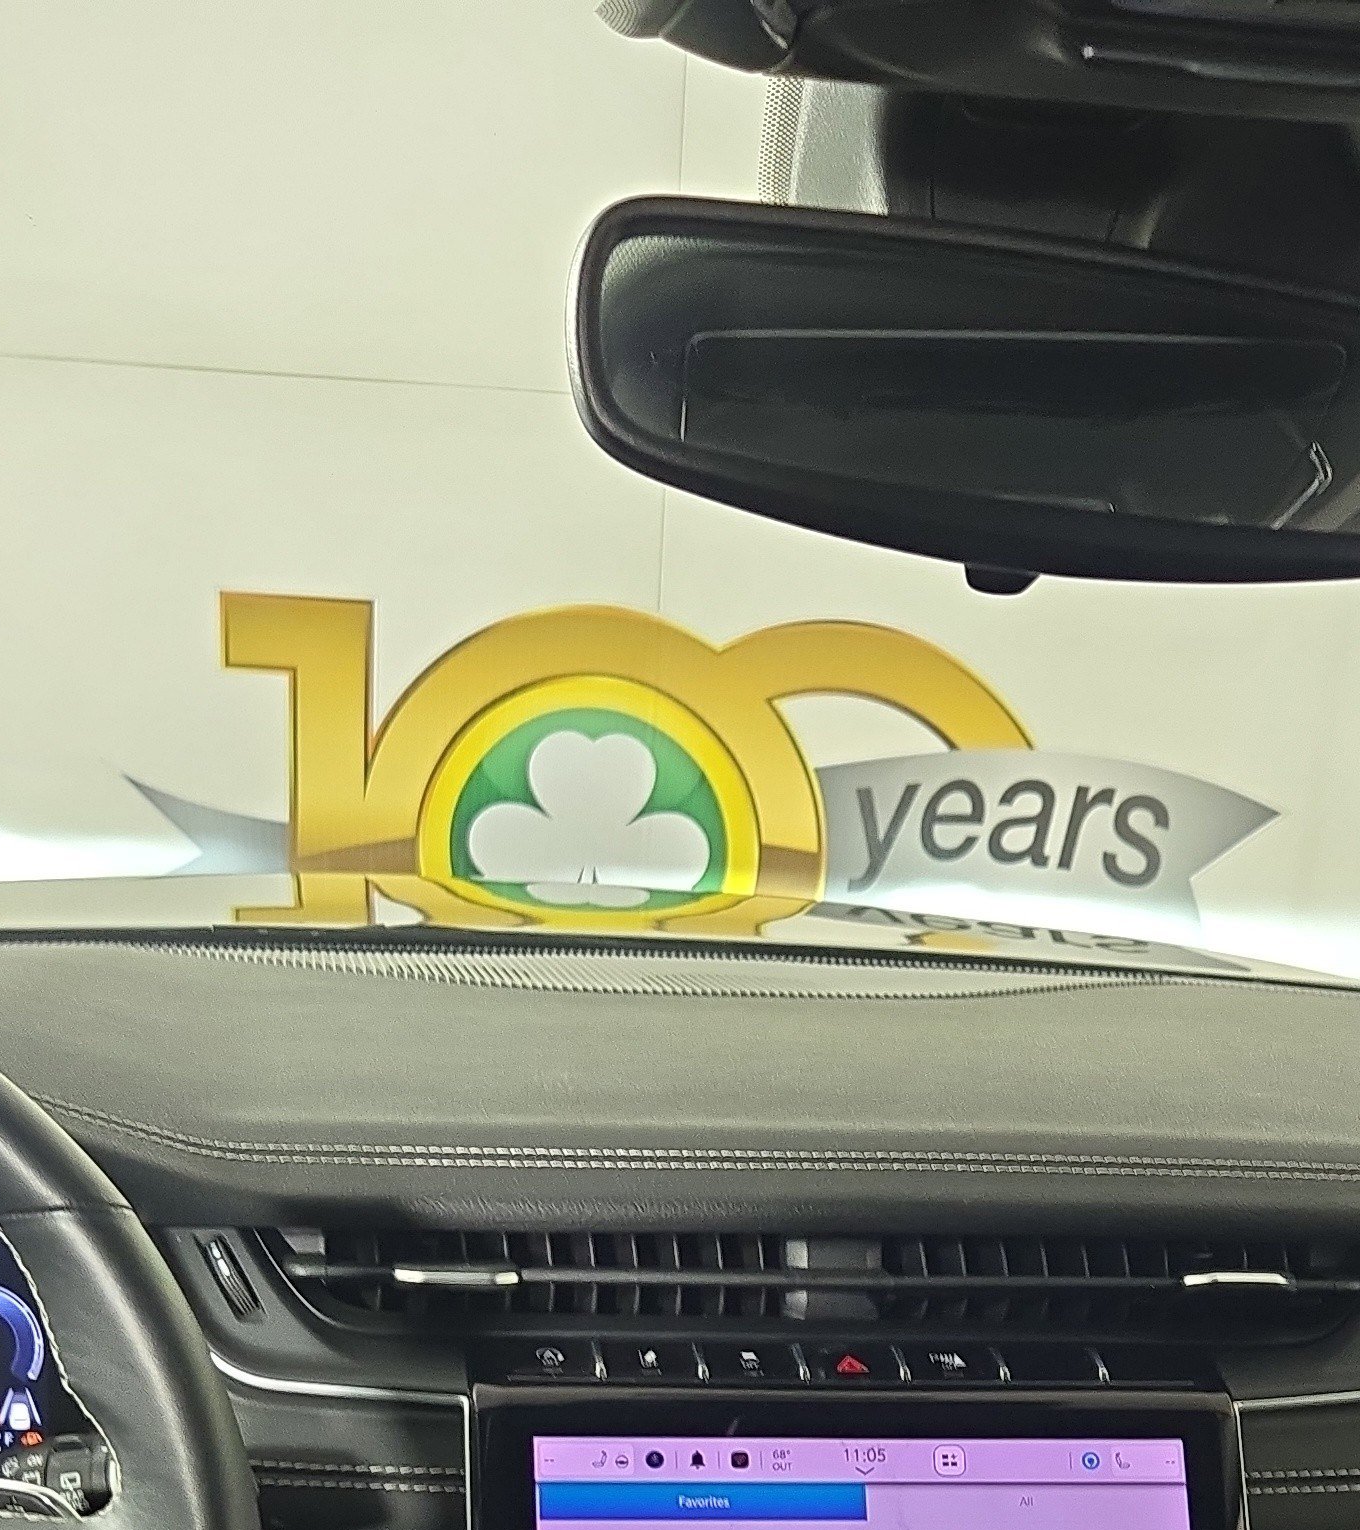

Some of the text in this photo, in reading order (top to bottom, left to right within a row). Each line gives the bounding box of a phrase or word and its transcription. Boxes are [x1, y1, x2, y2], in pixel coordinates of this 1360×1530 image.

[848, 767, 1173, 893] years
[844, 1447, 887, 1463] 11:05
[772, 1461, 792, 1472] OUT
[678, 1494, 731, 1509] Favorites
